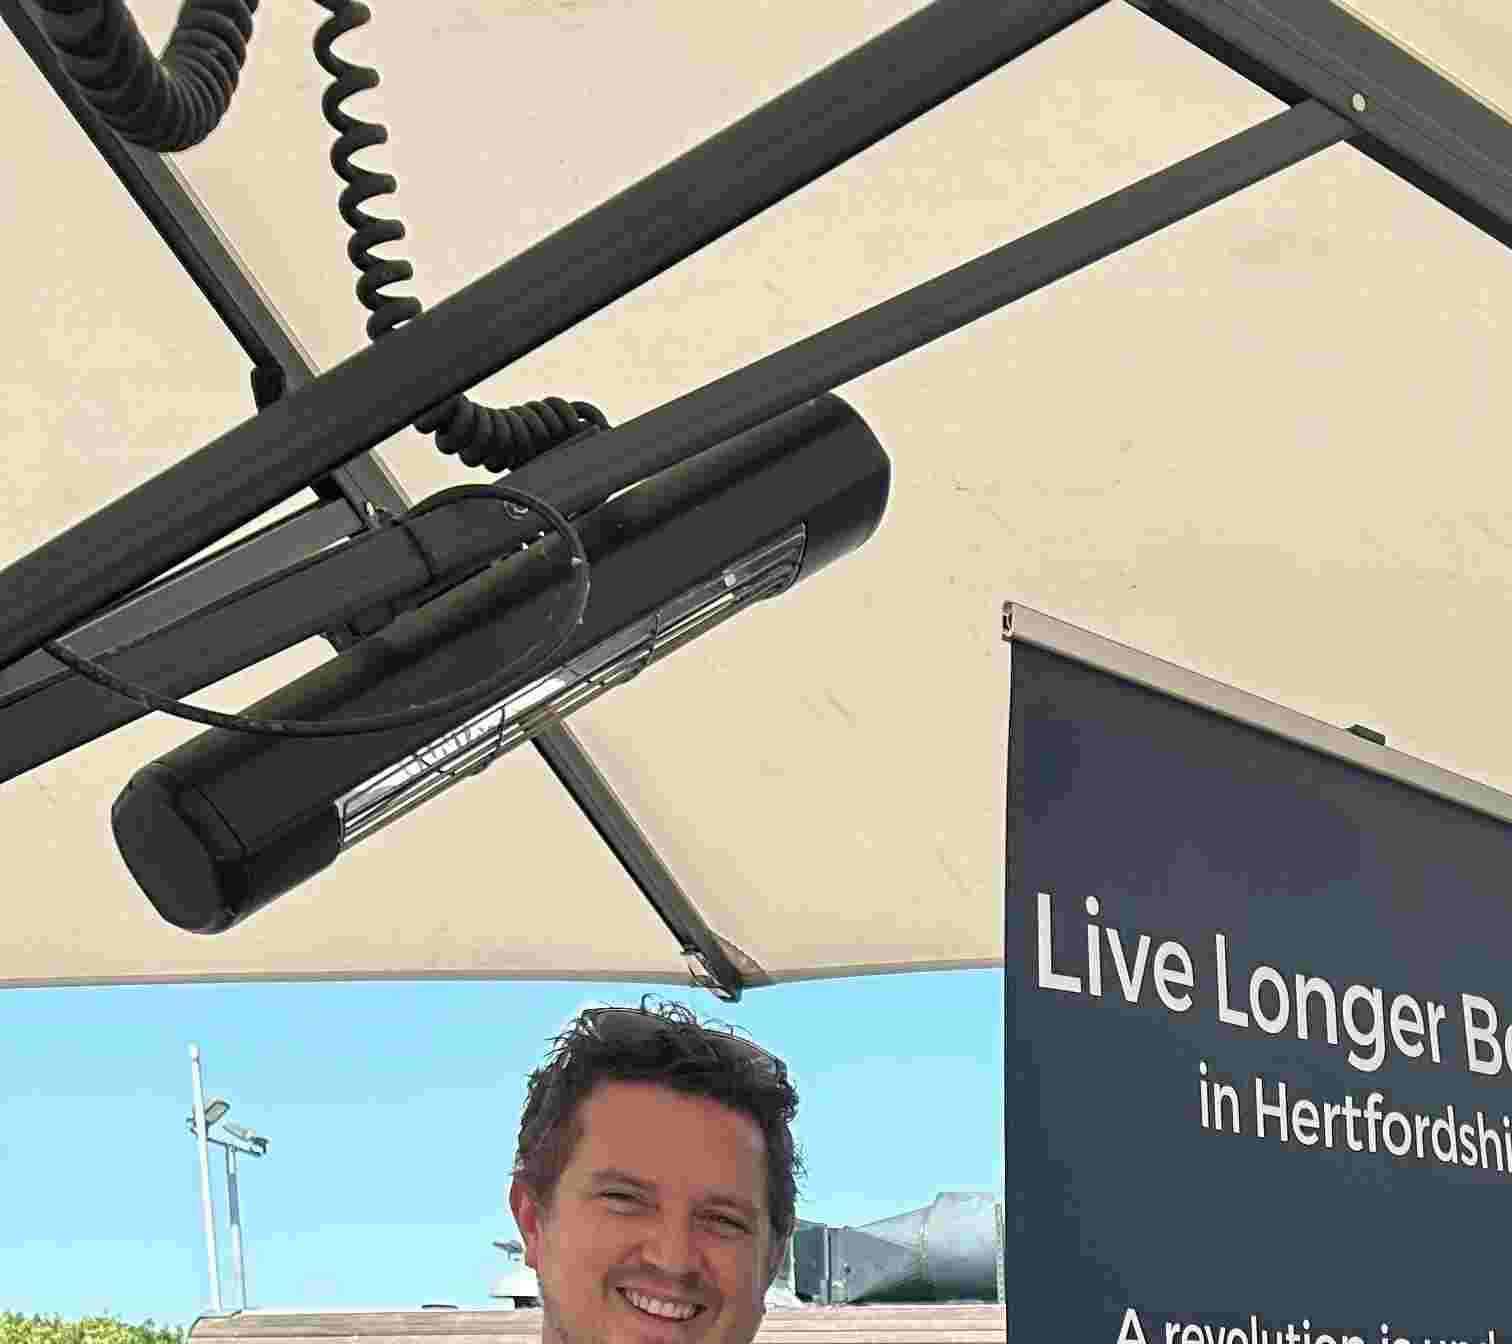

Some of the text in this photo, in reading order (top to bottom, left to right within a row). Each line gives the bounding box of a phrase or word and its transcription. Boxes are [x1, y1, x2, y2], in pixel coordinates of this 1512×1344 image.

[1037, 892, 1194, 1012] Live
[1216, 934, 1445, 1072] Longer
[1199, 1062, 1240, 1134] in
